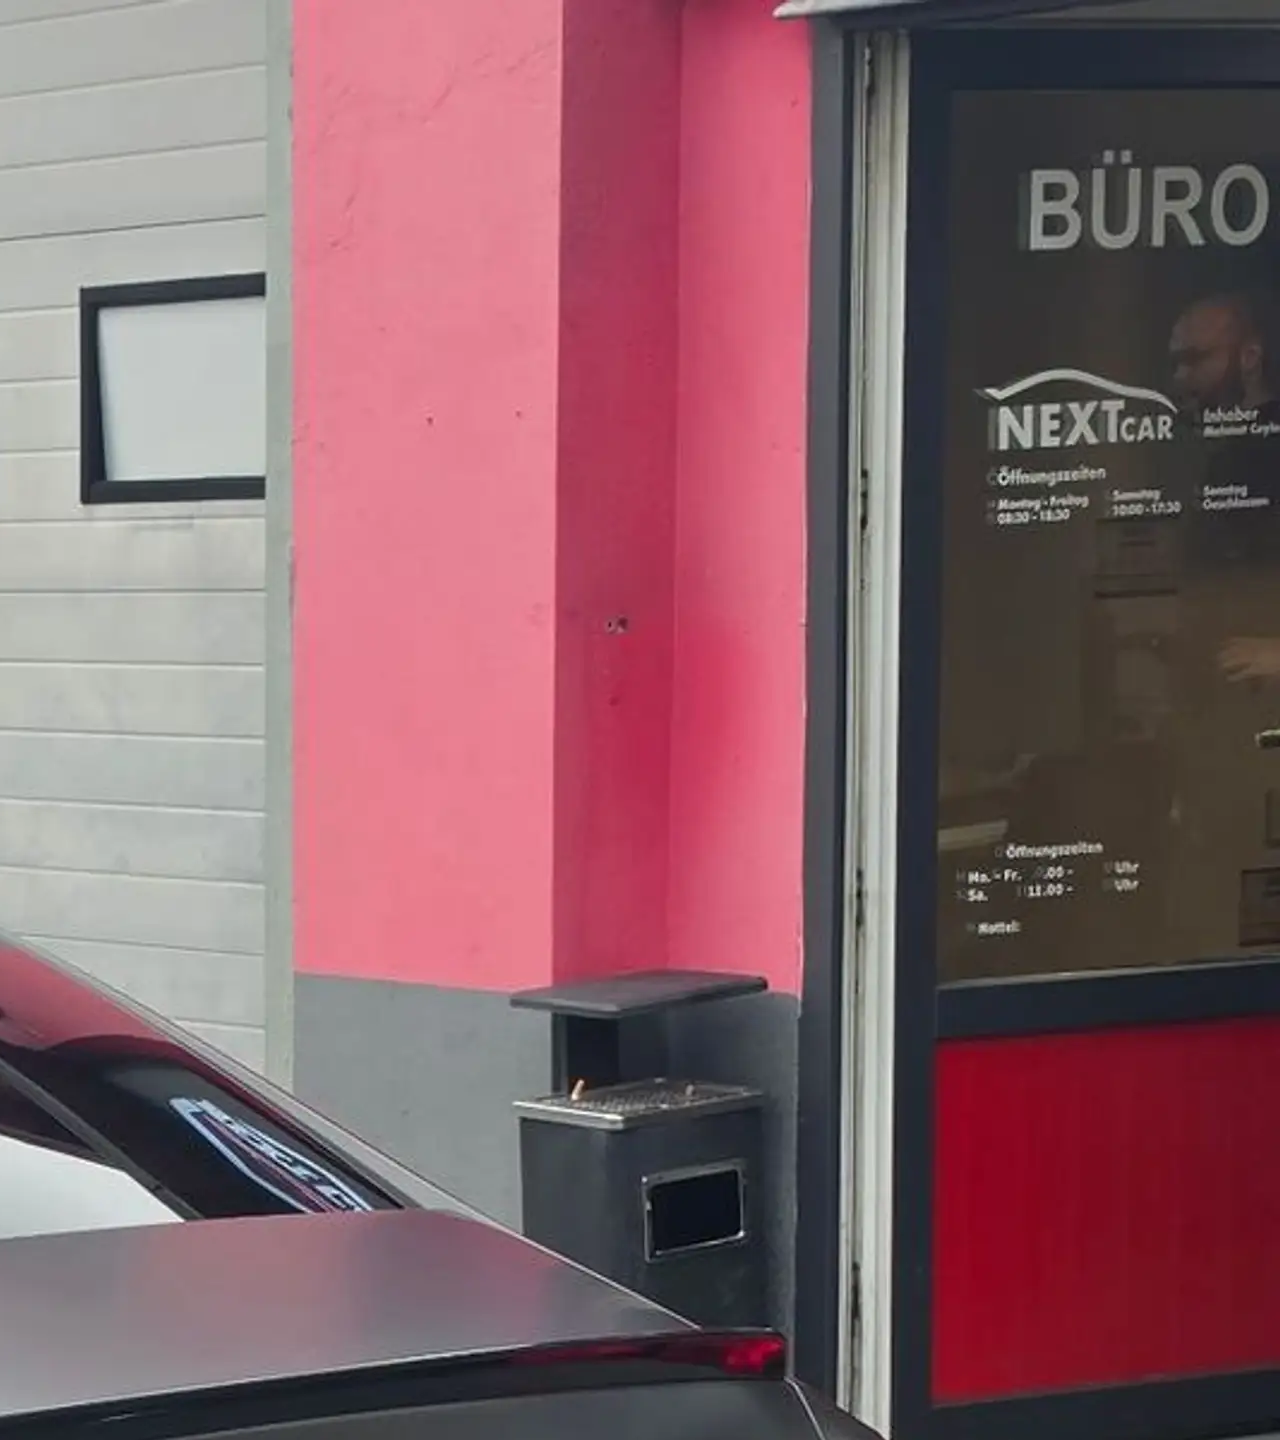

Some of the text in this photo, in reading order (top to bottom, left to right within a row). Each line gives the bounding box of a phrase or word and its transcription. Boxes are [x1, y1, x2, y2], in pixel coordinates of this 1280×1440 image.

[1028, 149, 1270, 250] BÜRO
[997, 463, 1106, 487] Öffnungszeiten
[1006, 841, 1104, 859] Öffnungszeiten
[1114, 861, 1139, 874] Uhr
[1114, 878, 1139, 892] Uhr
